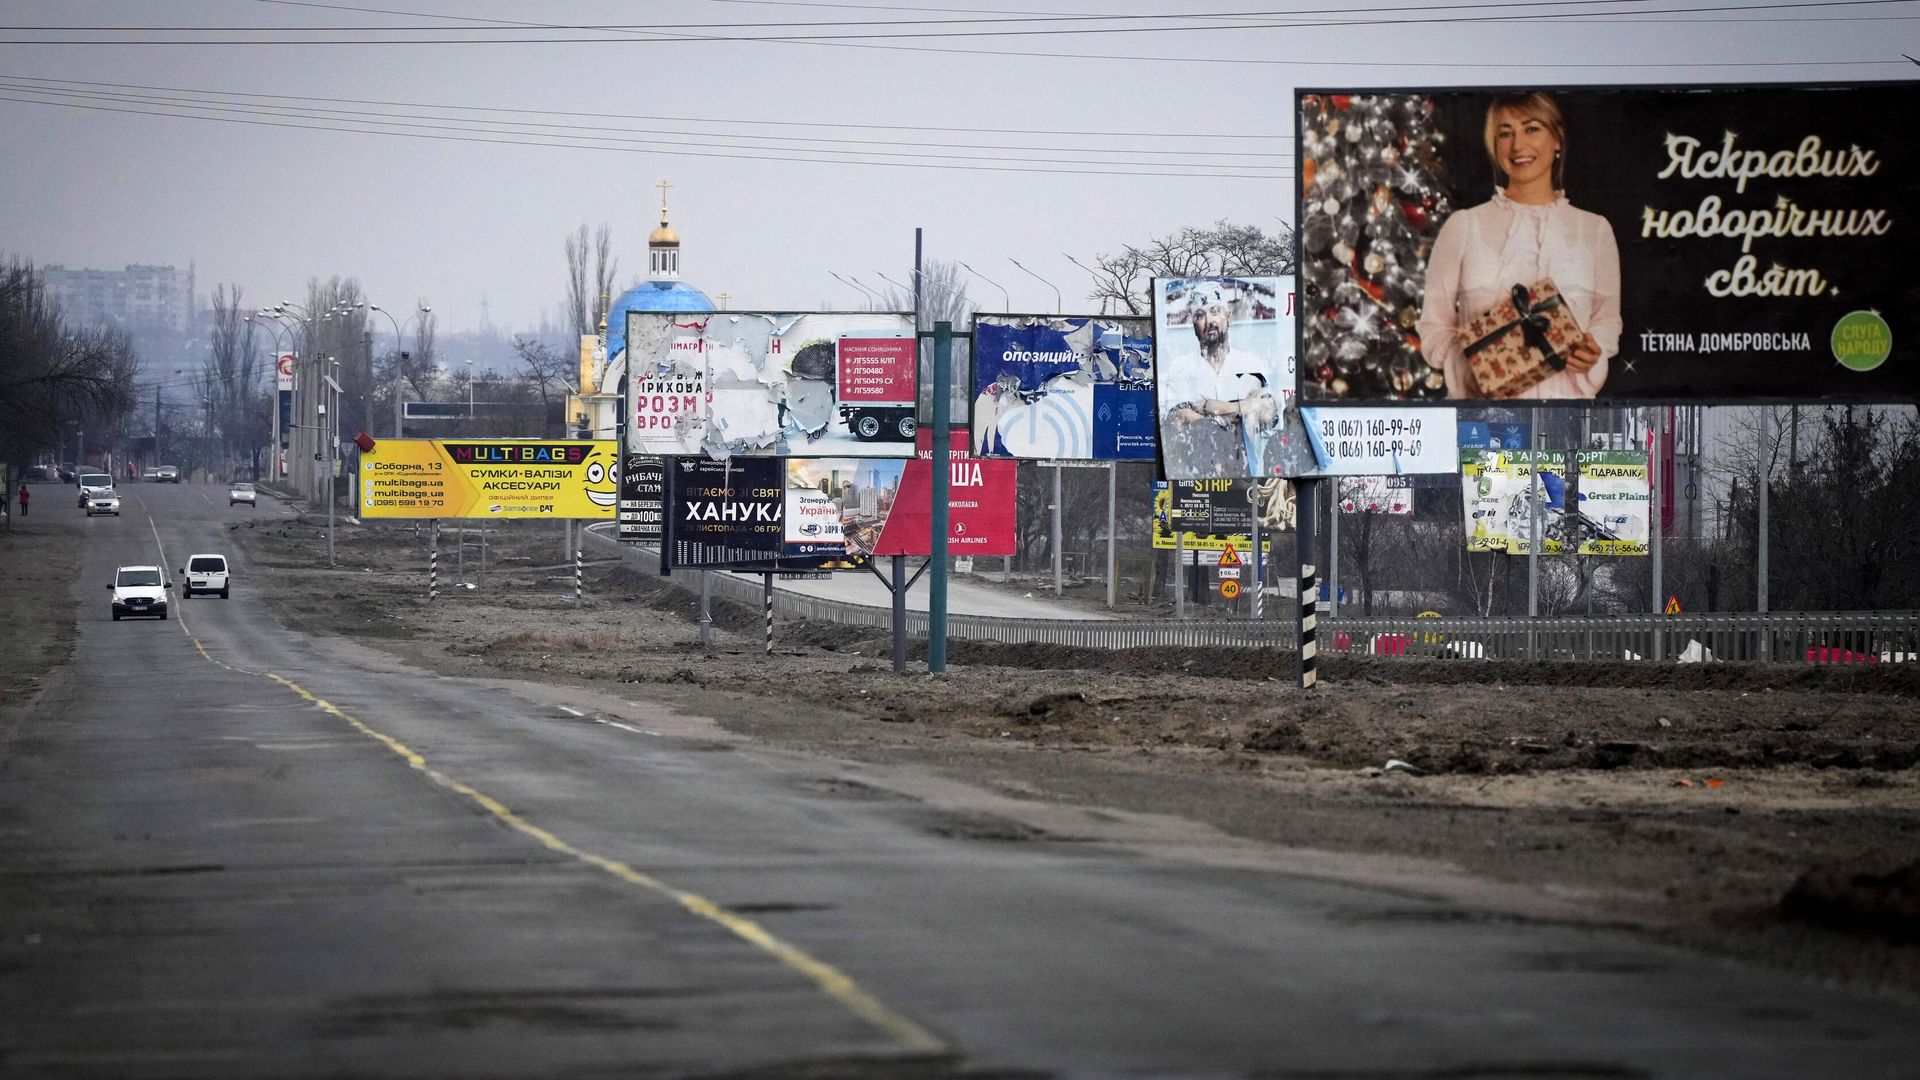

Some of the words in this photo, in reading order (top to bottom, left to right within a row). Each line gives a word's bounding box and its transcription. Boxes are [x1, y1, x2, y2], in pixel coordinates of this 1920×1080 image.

[1658, 131, 1881, 193] Яскравих
[1641, 195, 1892, 253] новорічних
[1842, 325, 1881, 337] СЛУГА
[1640, 333, 1695, 352] ТЕТЯНА
[1700, 333, 1811, 353] ДОМБРОВСЬКА
[1838, 340, 1888, 356] НАРОДУ
[1338, 419, 1363, 438] (067)
[1366, 419, 1421, 436] 160-99-69
[457, 447, 581, 460] MULTIBAGS
[1339, 441, 1363, 459] (066)
[1366, 441, 1421, 457] 160-99-69
[374, 462, 424, 472] Соборна,
[1591, 468, 1641, 477] ГІДРАВЛІК
[471, 470, 518, 478] СУМКИ
[525, 470, 573, 479] ВАЛІЗИ
[950, 463, 983, 487] ША
[374, 479, 444, 489] multibags.ua
[483, 482, 560, 490] АКСЕСУАРИ
[1387, 477, 1407, 488] 095
[374, 489, 444, 499] multibags_ua
[686, 488, 735, 497] ВІТАЄМО
[1588, 491, 1616, 500] Great
[1619, 492, 1649, 501] Plains
[640, 511, 654, 522] 100
[1224, 585, 1236, 593] 40
